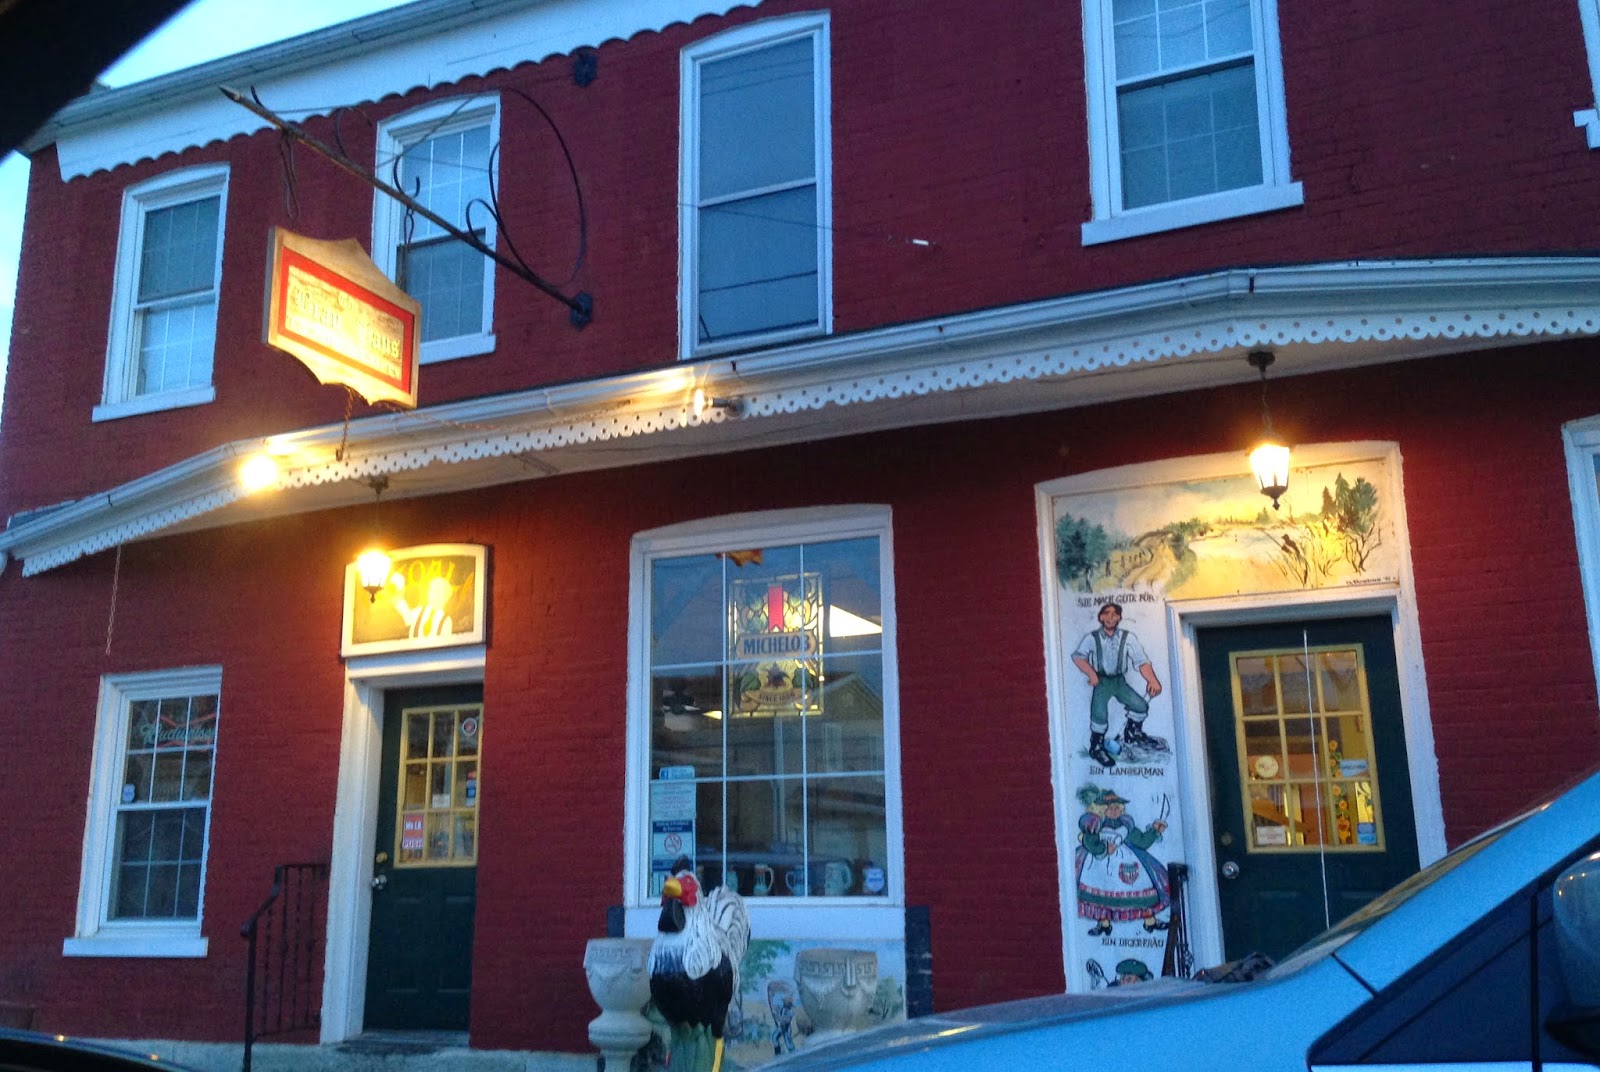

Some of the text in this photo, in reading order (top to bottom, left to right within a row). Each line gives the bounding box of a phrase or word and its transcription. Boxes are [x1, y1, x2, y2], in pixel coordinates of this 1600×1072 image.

[1078, 597, 1092, 607] SIE
[1115, 594, 1136, 604] GUTE
[744, 636, 810, 655] MICHELOB
[1090, 766, 1104, 775] EIN
